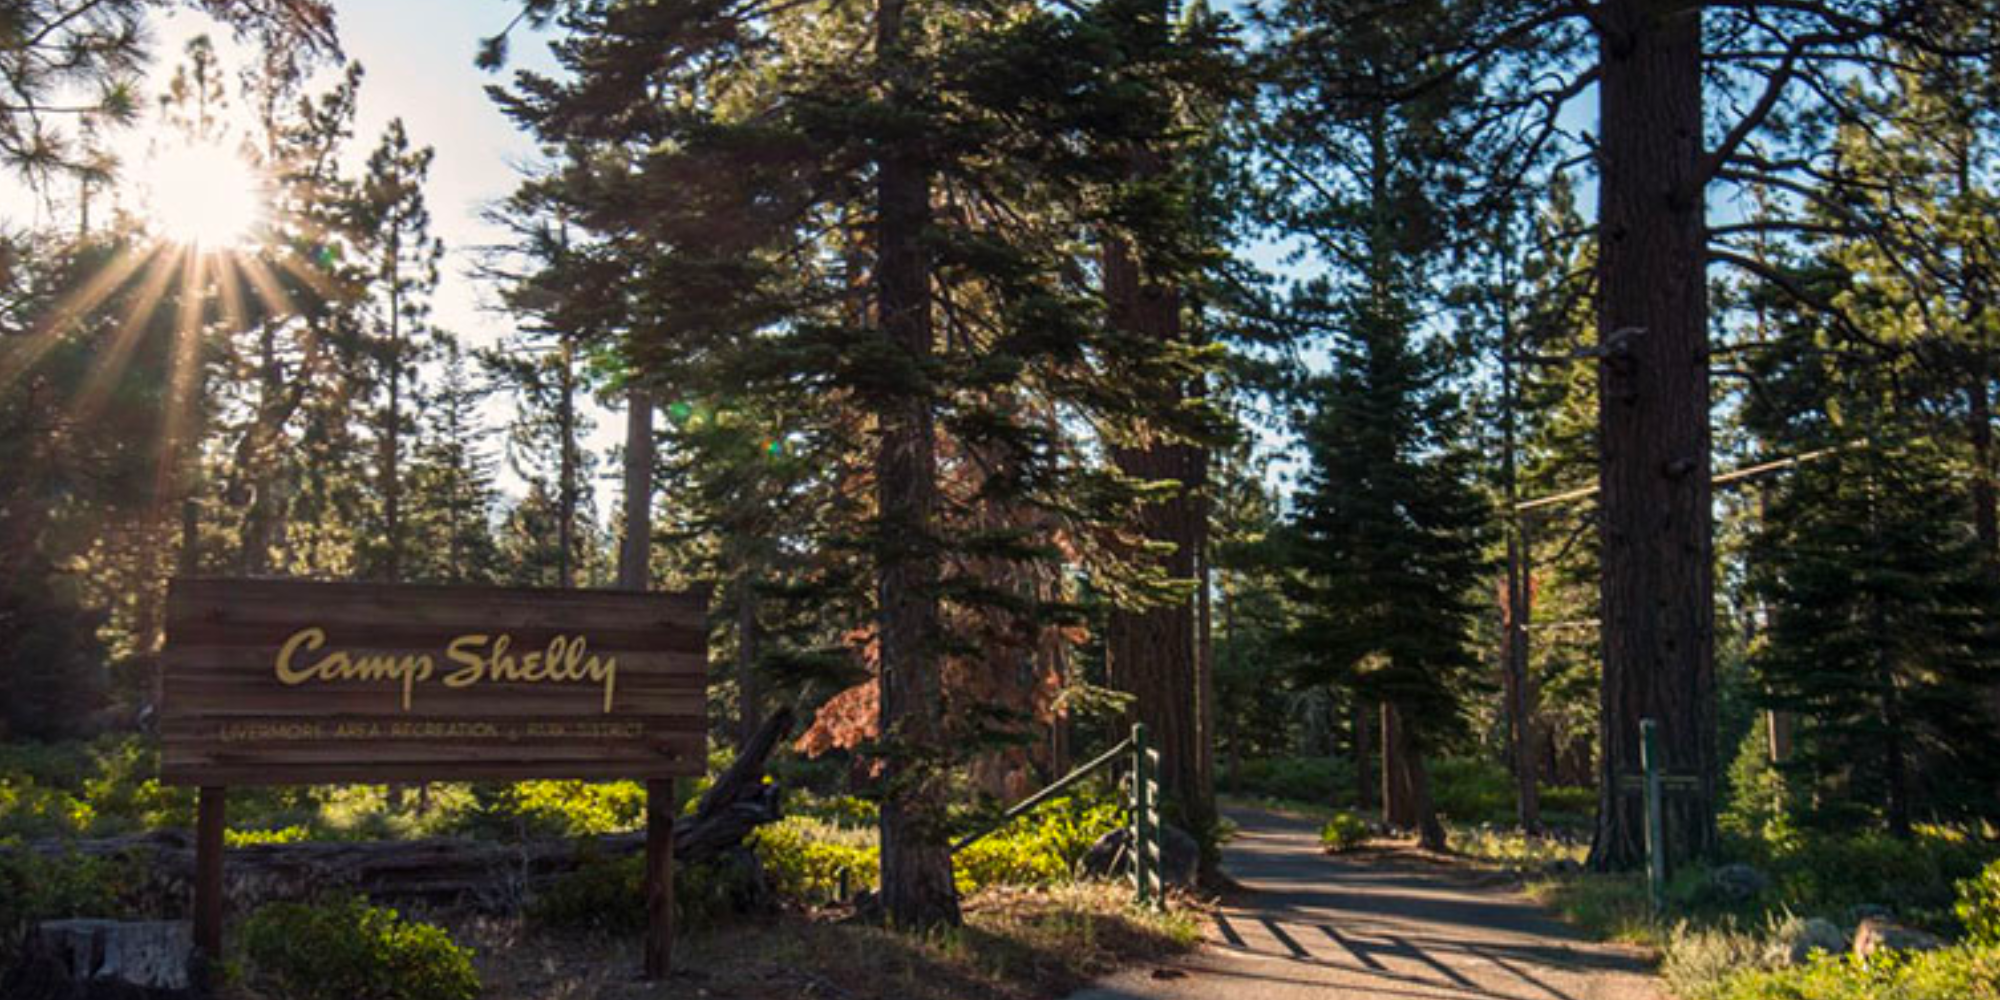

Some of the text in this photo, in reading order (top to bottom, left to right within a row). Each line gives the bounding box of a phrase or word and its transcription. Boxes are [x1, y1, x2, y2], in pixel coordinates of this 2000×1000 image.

[276, 628, 617, 713] Camp Shelly
[334, 722, 380, 737] AREA
[391, 722, 498, 737] RECREATION
